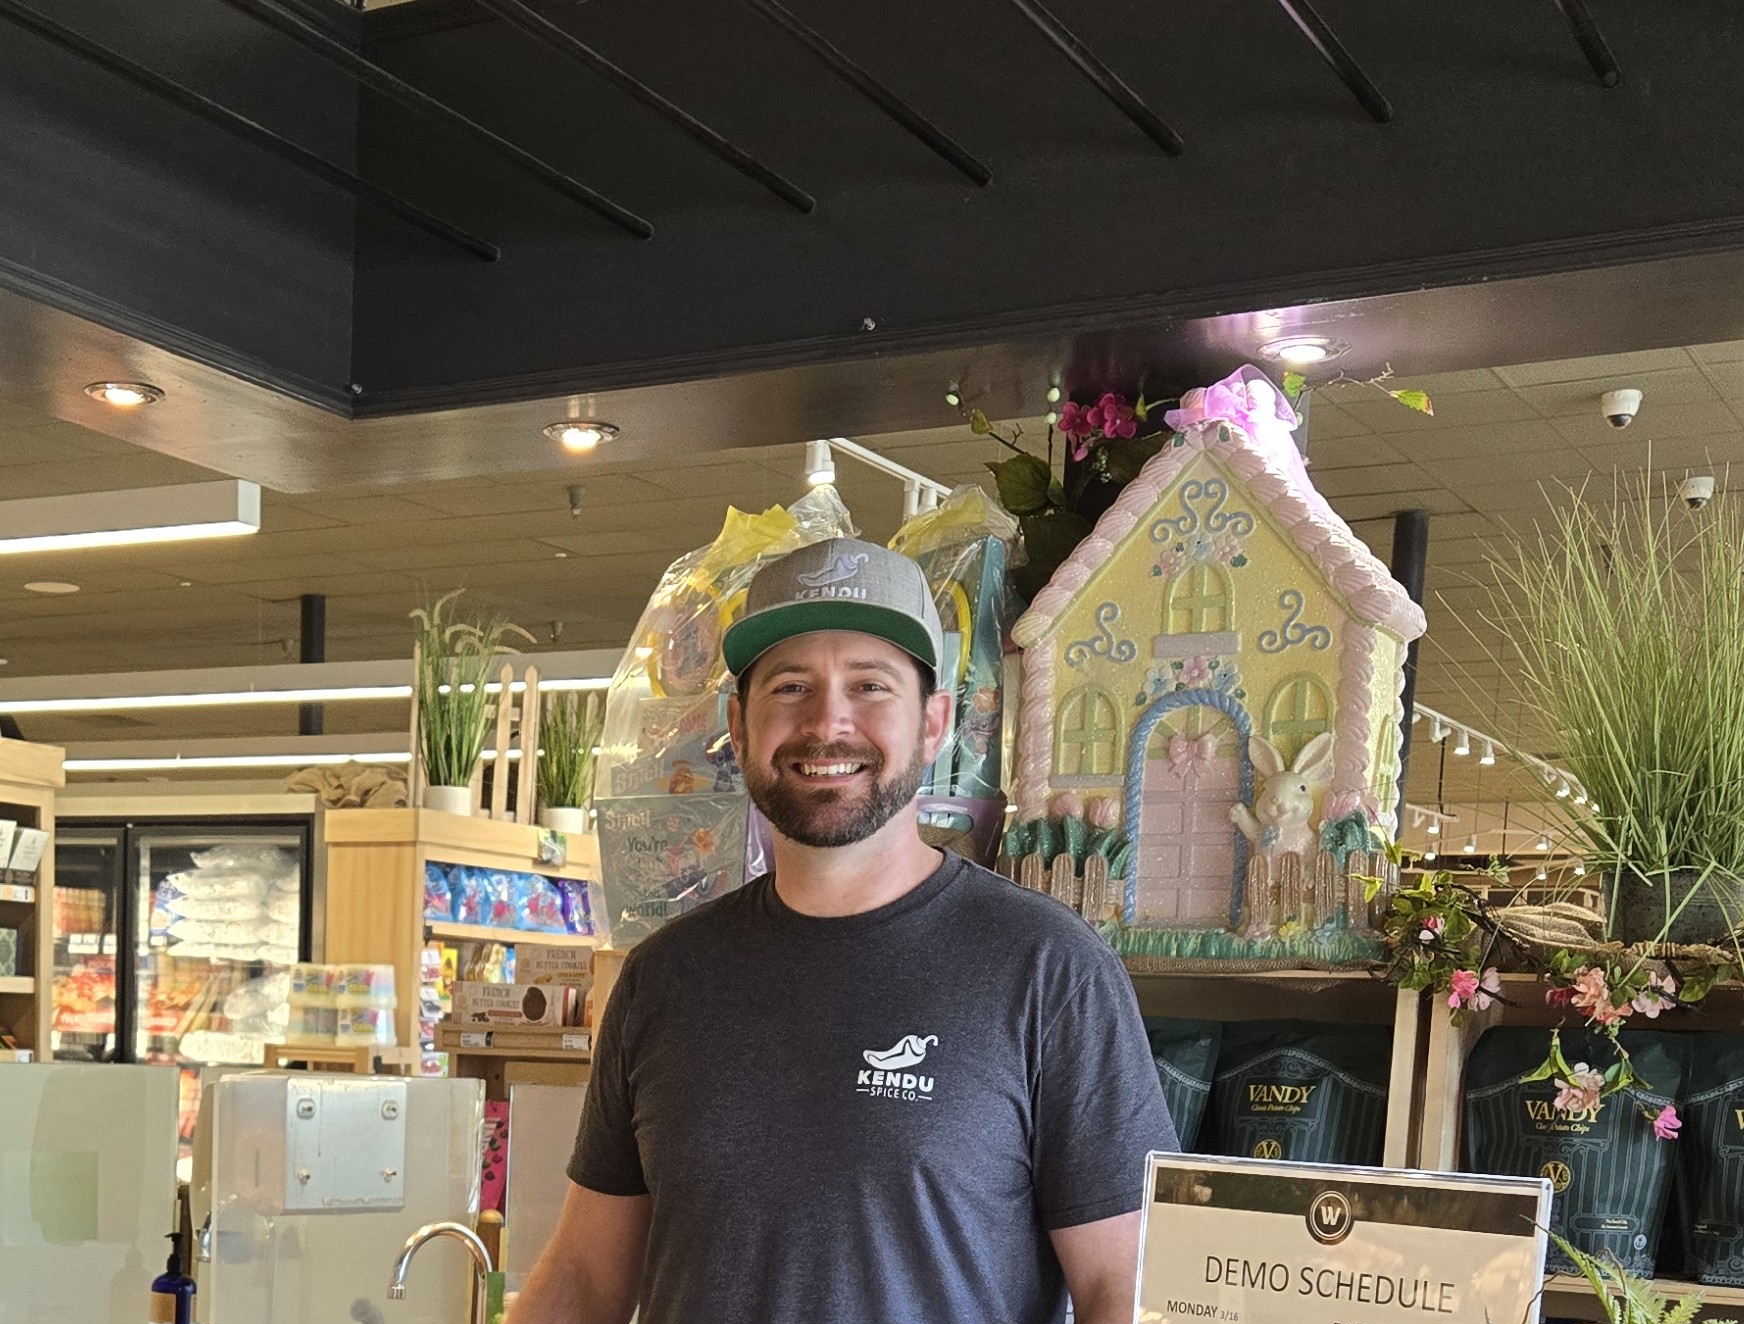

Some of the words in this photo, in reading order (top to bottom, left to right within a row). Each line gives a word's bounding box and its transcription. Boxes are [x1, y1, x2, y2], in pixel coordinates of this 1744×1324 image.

[857, 1070, 934, 1093] KENDU
[870, 1086, 900, 1099] SPICE
[1249, 1084, 1316, 1104] VANDY
[1285, 1105, 1301, 1114] Chips
[1570, 1123, 1591, 1135] Chips
[1319, 1206, 1341, 1225] W
[1205, 1255, 1289, 1293] DEMO
[1298, 1266, 1454, 1313] SCHEDULE
[1166, 1299, 1217, 1318] MONDAY
[1219, 1310, 1239, 1322] 3/16
